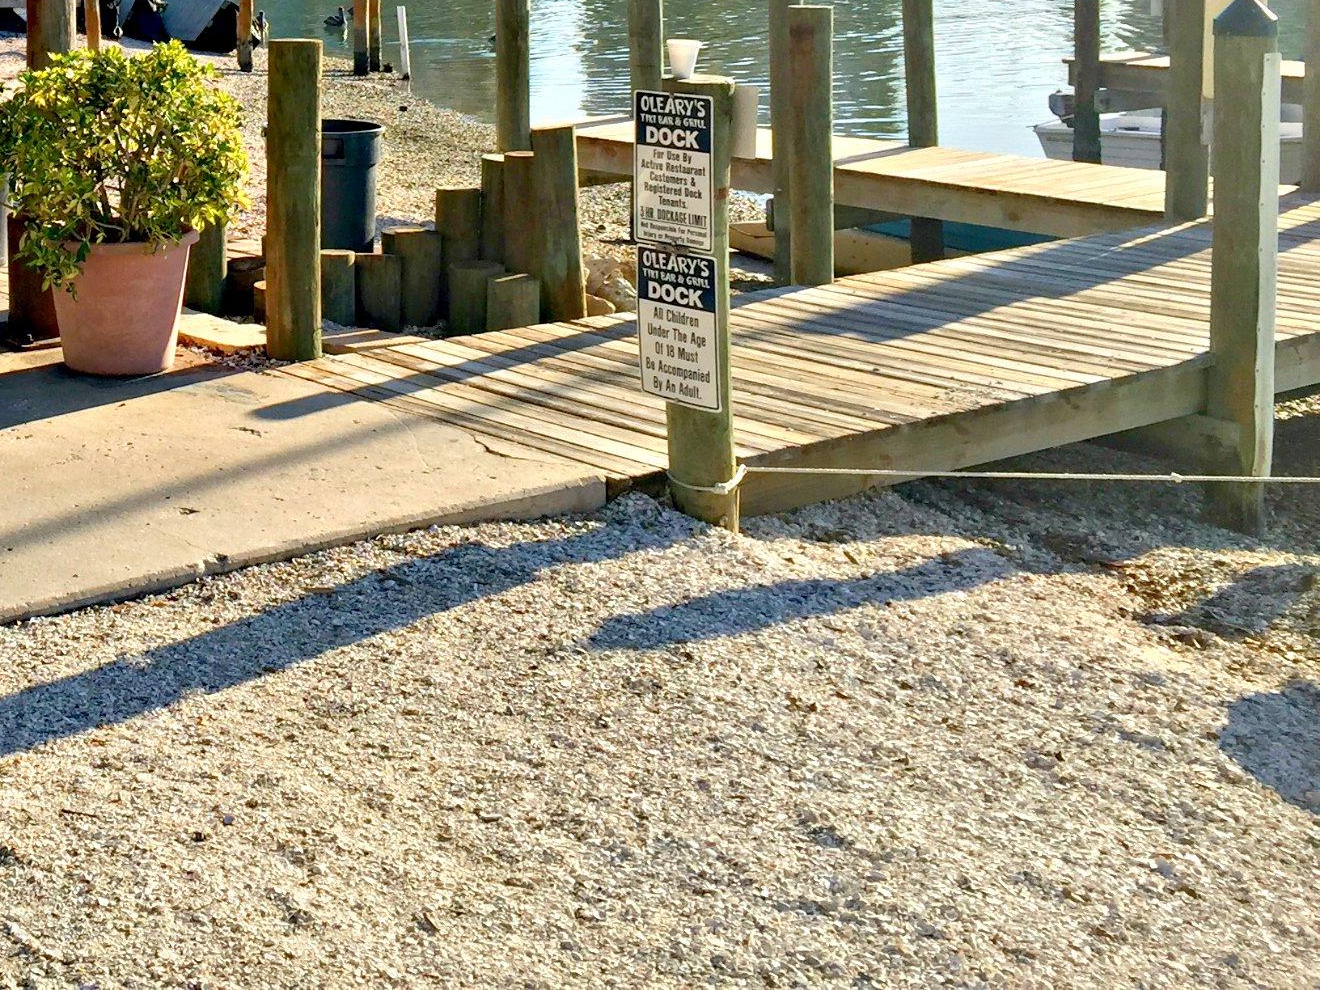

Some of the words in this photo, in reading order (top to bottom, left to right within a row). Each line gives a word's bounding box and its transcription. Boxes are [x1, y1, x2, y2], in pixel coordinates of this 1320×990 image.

[641, 95, 706, 118] OLEARY'S
[640, 113, 657, 123] TIKI
[658, 115, 674, 126] BAR
[675, 117, 682, 127] &
[683, 118, 707, 129] GRILL
[645, 125, 699, 149] DOCK
[641, 159, 663, 171] Active
[666, 162, 706, 176] Restaurant
[653, 149, 664, 159] For
[667, 151, 680, 162] Use
[683, 152, 692, 164] By
[649, 171, 688, 186] Customers
[690, 177, 696, 187] &
[644, 182, 682, 196] Registered
[684, 187, 702, 199] Dock
[650, 222, 677, 233] Responsible
[657, 209, 687, 224] DOCKAGE
[688, 213, 707, 227] LIMIT
[642, 250, 710, 277] OLEARY'S
[642, 267, 659, 279] TIKI
[660, 270, 676, 283] BAR
[677, 275, 684, 284] &
[686, 275, 711, 289] GRILL
[647, 280, 704, 308] DOCK
[653, 307, 664, 320] All
[666, 309, 699, 328] Children
[647, 322, 669, 339] Under
[672, 328, 687, 343] The
[690, 332, 706, 348] Age
[655, 341, 663, 355] Of
[666, 344, 675, 358] 18
[677, 347, 698, 363] Must
[645, 356, 655, 370] Be
[658, 360, 710, 384] Accompanied
[653, 376, 663, 391] By
[665, 379, 676, 393] An
[679, 382, 702, 399] Adult.
